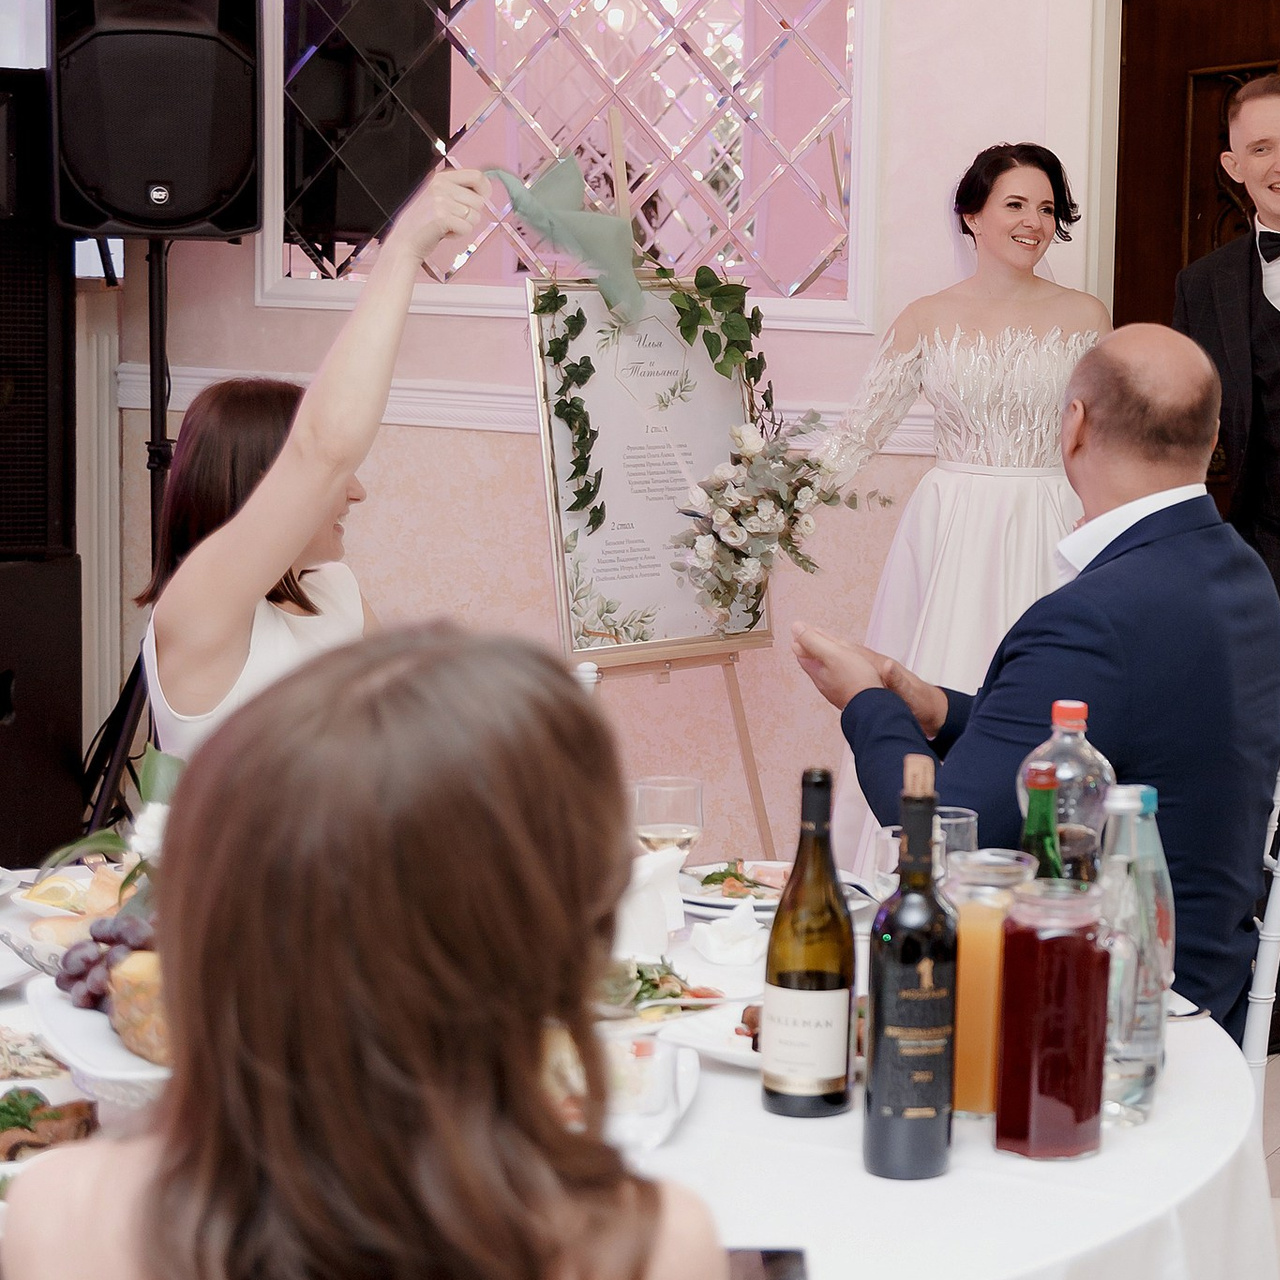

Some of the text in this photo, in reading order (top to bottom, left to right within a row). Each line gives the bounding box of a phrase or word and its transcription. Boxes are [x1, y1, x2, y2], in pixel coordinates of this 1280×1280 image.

[635, 333, 663, 348] Илья
[621, 361, 680, 378] Татьяна
[611, 521, 635, 531] 2 стол
